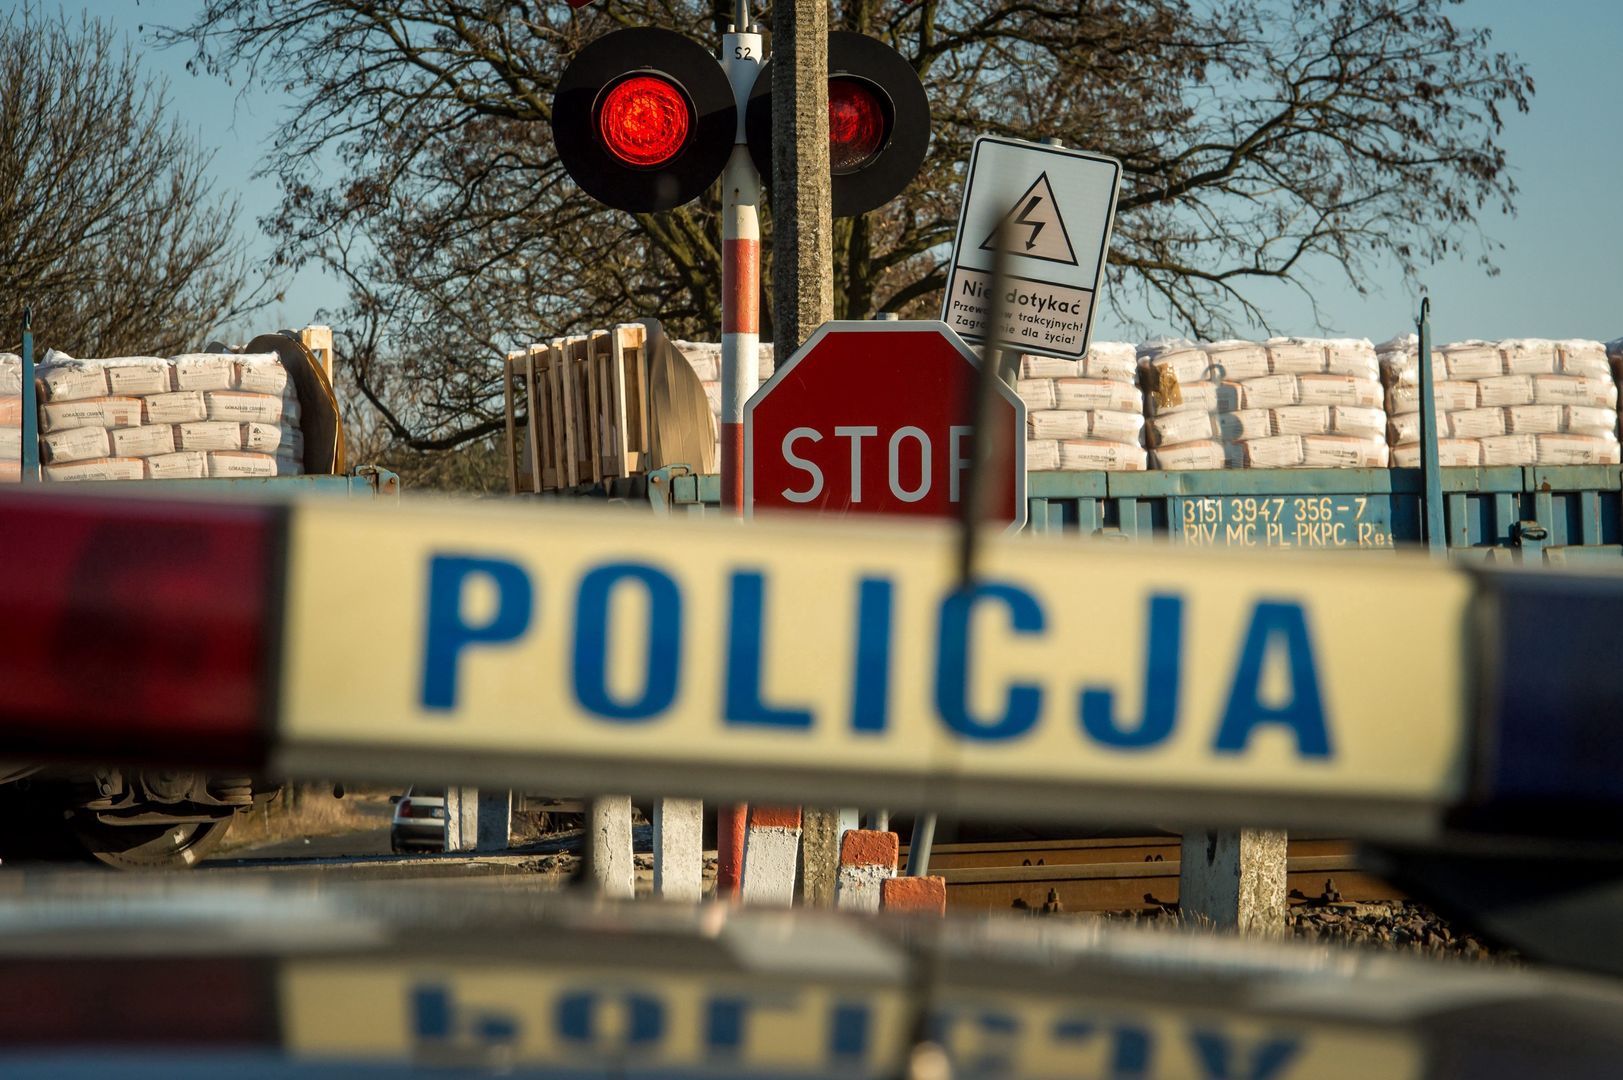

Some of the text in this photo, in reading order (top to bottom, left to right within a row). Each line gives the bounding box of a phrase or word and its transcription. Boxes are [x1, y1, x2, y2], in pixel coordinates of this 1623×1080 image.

[734, 46, 752, 61] S2
[962, 280, 1081, 315] Nie dotykać
[1018, 312, 1083, 332] trakcyjnych!
[1021, 327, 1039, 338] dla
[1044, 331, 1076, 344] życia!
[1183, 499, 1223, 523] 3151
[1231, 498, 1285, 522] 3947
[1184, 523, 1218, 547] RIV
[1226, 523, 1257, 547] MC
[1267, 522, 1347, 547] PL-PKPC
[416, 549, 1336, 759] POLICJA
